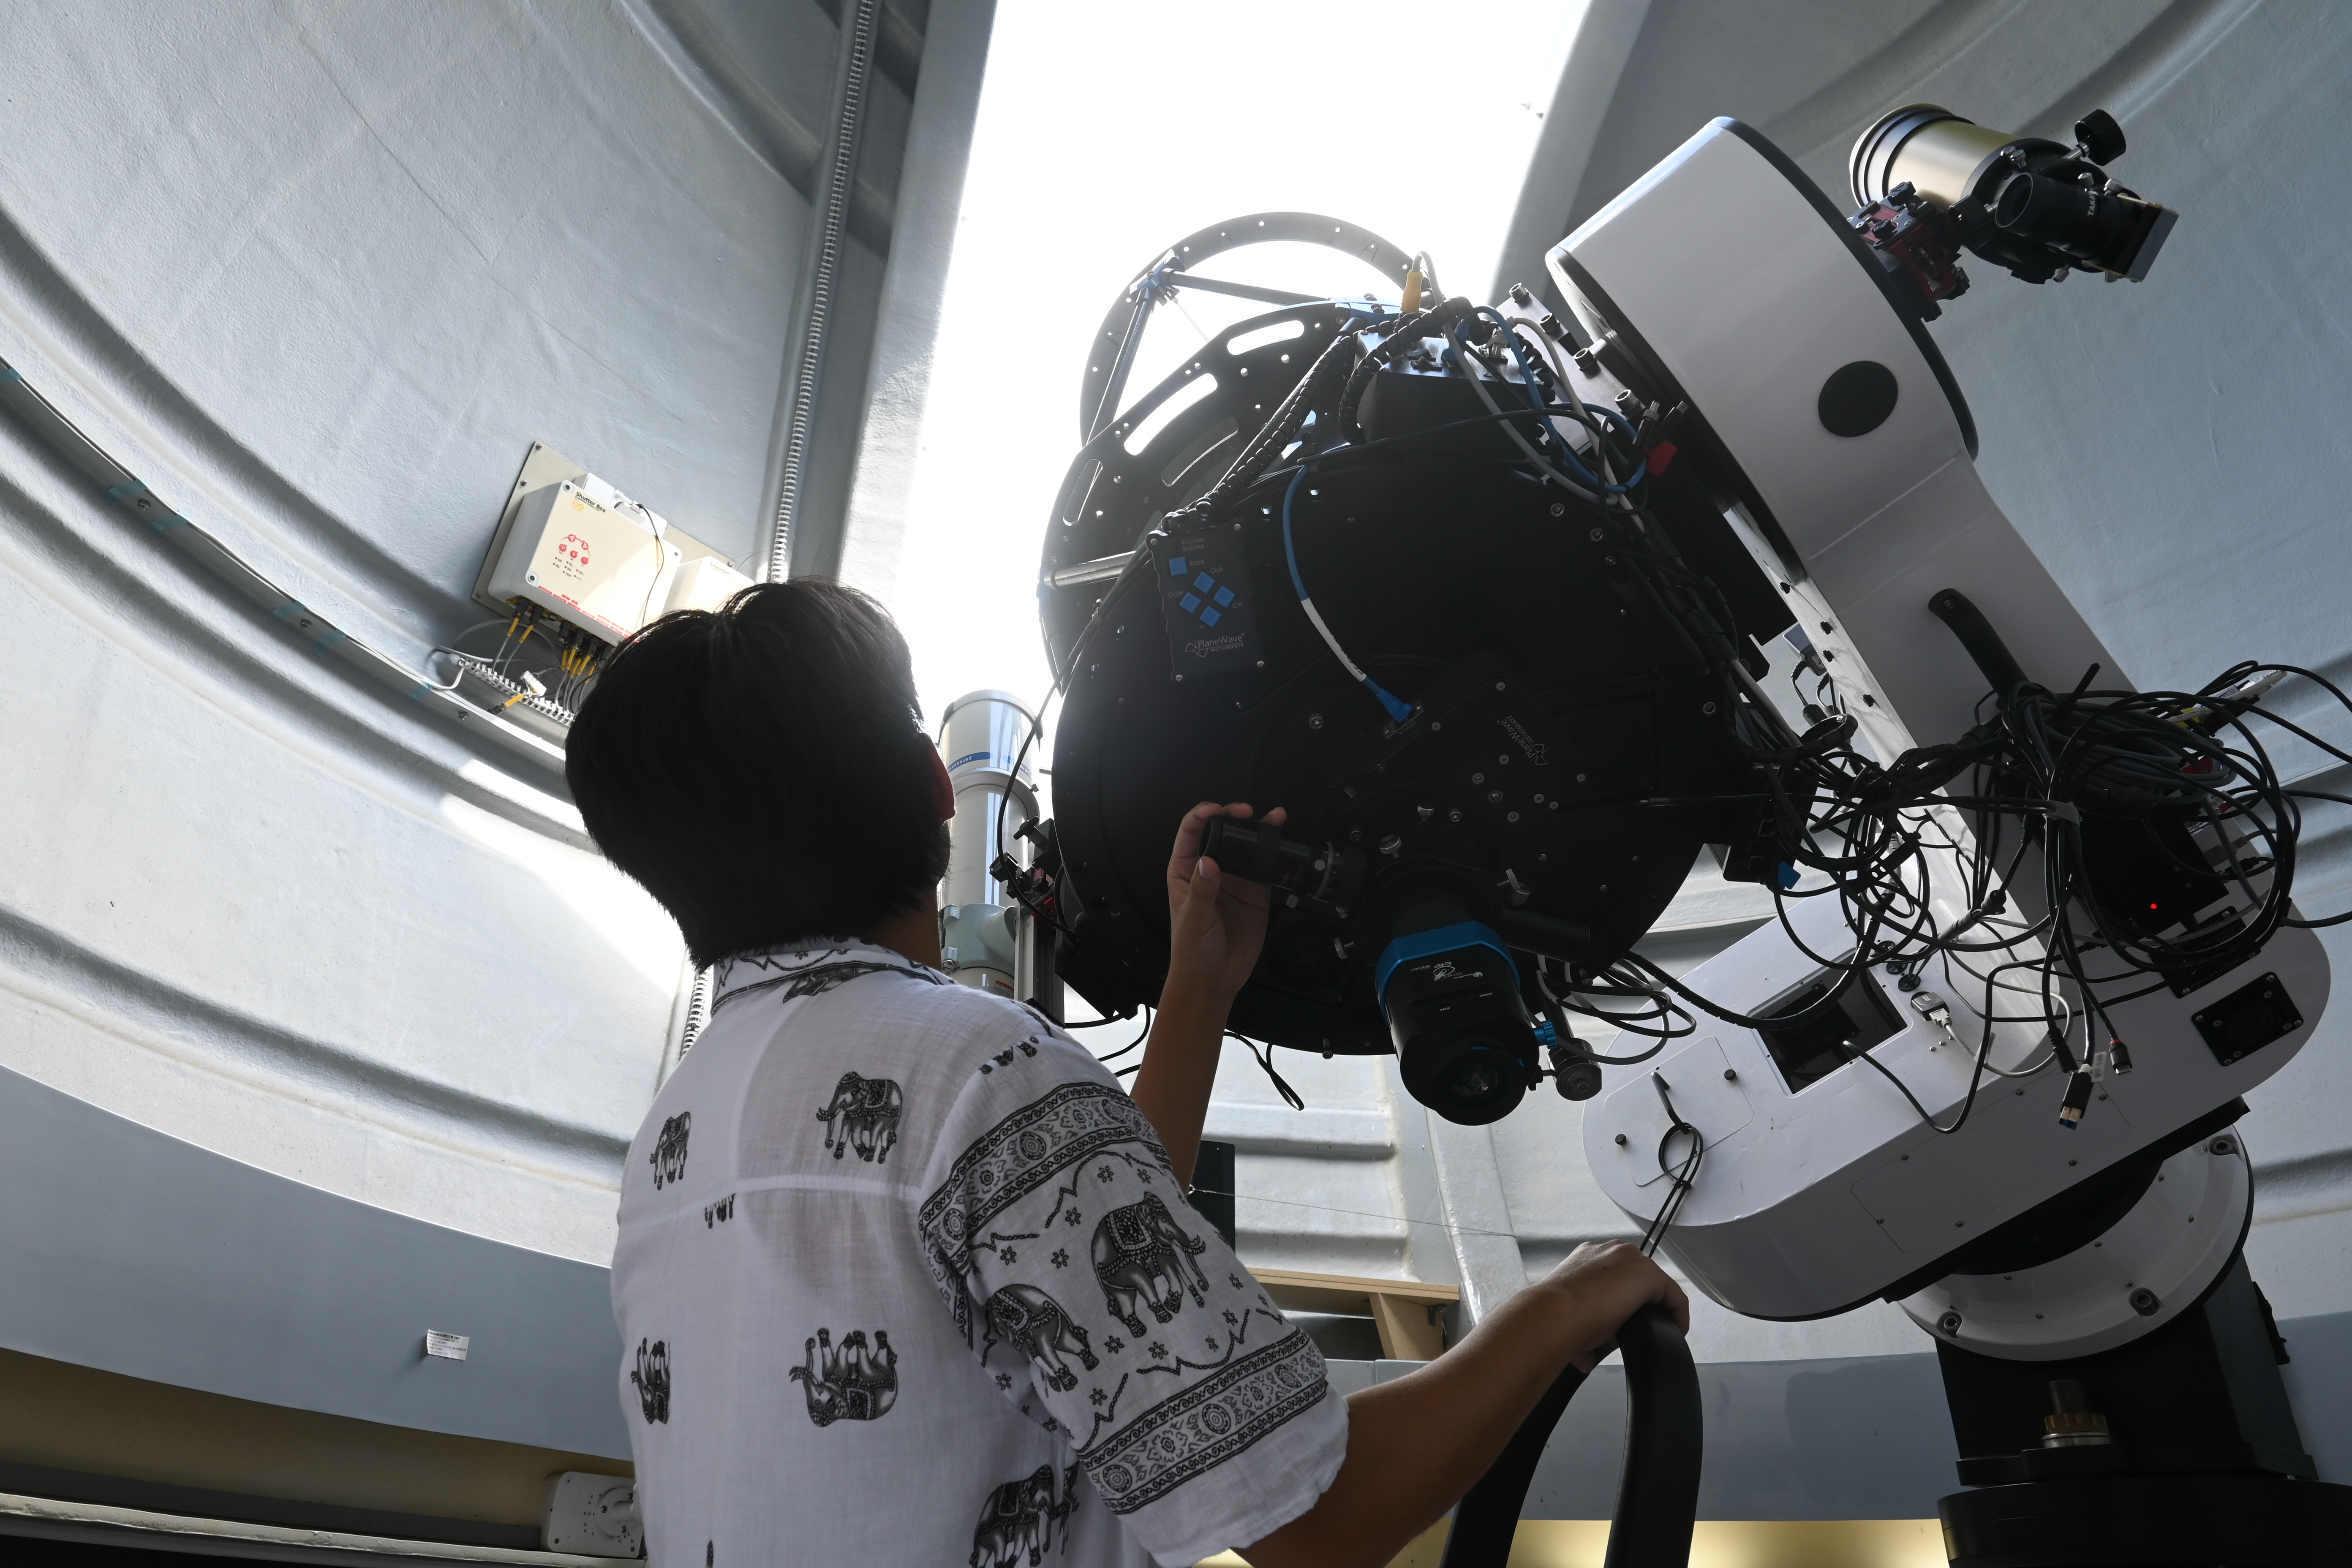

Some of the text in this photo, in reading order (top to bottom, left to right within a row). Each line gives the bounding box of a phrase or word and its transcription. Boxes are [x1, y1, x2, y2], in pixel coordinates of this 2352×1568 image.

[2087, 192, 2097, 216] TAKA
[576, 492, 595, 506] Shutter
[596, 504, 606, 513] Box
[1181, 537, 1204, 545] Focuser
[710, 562, 730, 575] Inverter
[1198, 635, 1243, 648] PlaneWave
[1210, 643, 1244, 653] INSTRUMENTS
[1508, 715, 1534, 743] INSTRUMENTS
[1501, 719, 1536, 758] PlaneWave
